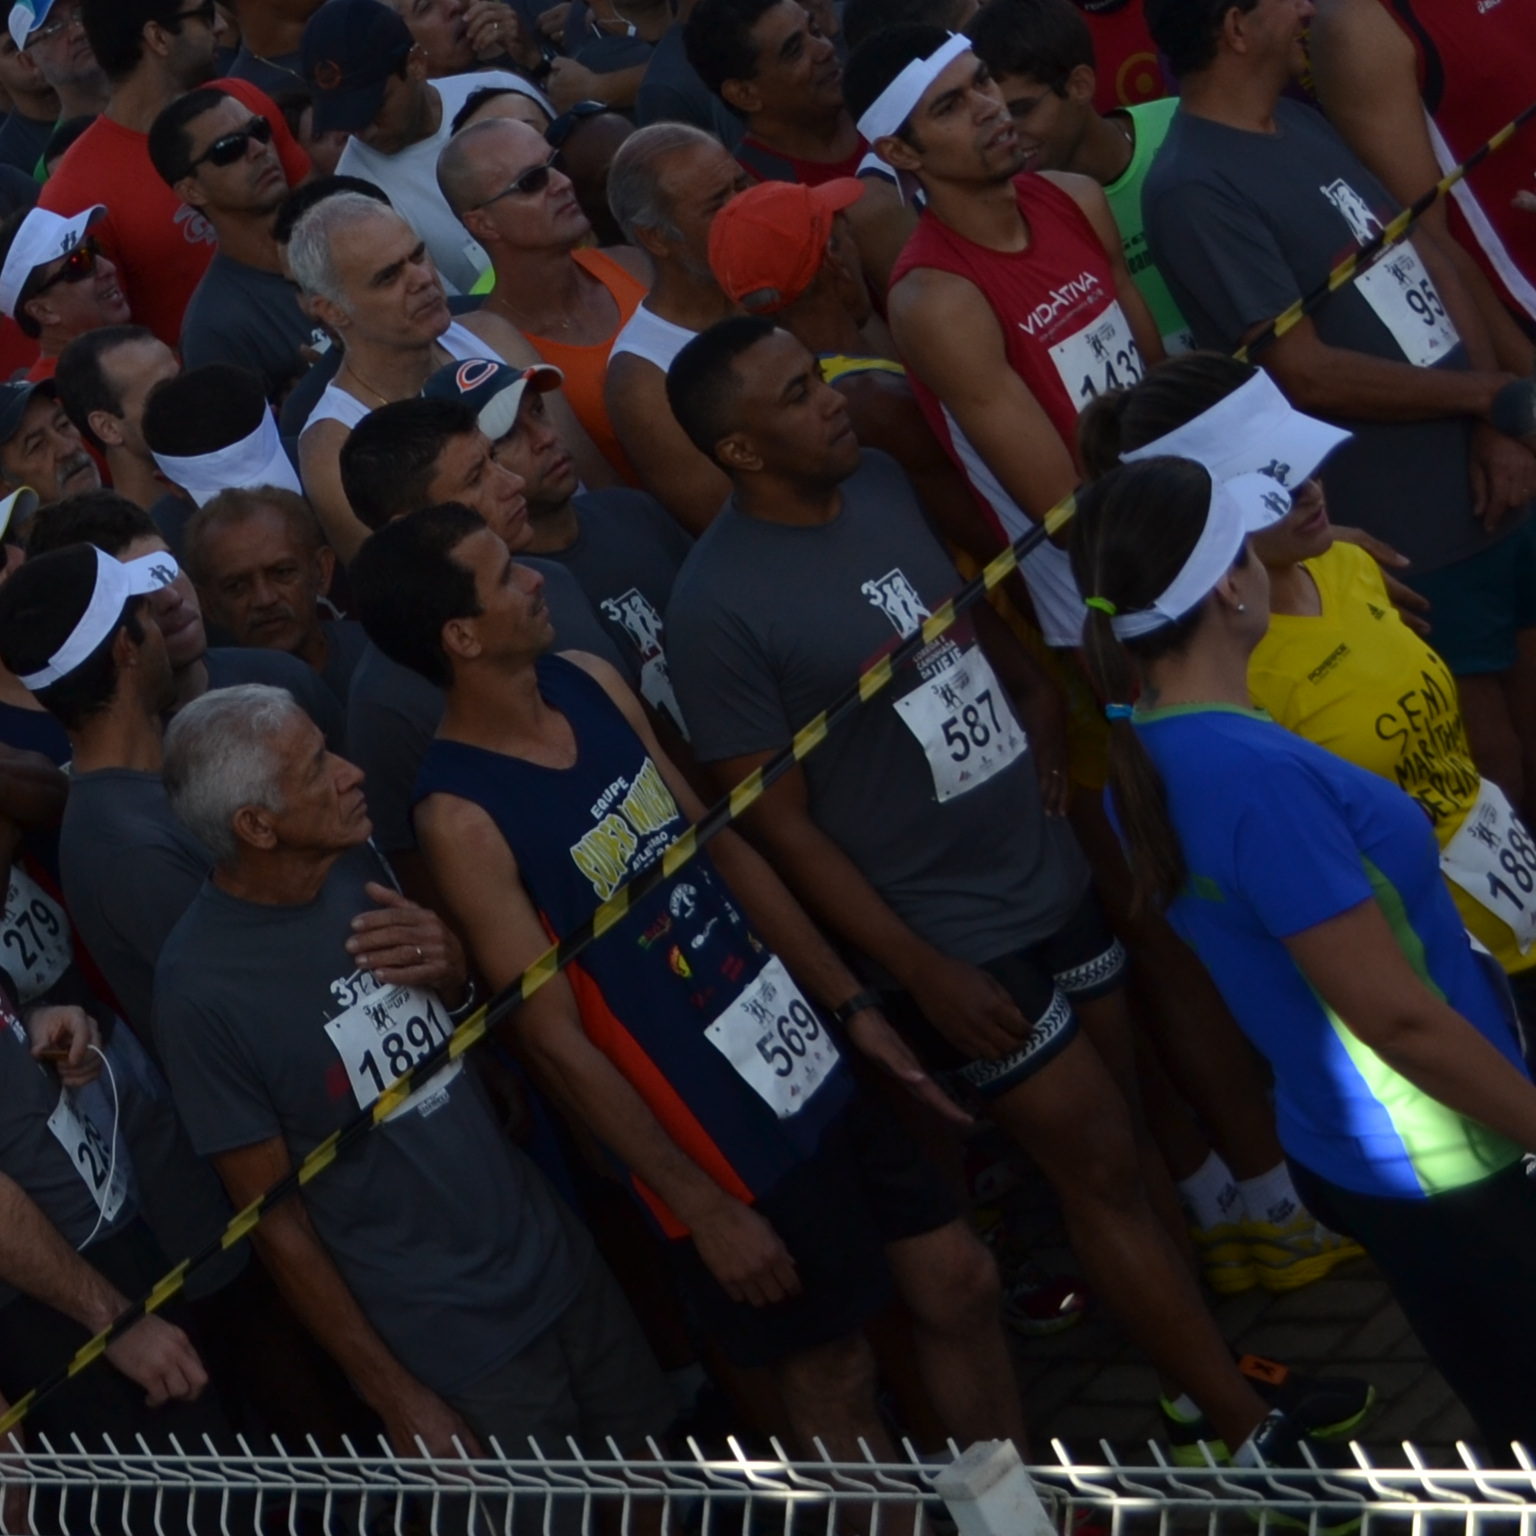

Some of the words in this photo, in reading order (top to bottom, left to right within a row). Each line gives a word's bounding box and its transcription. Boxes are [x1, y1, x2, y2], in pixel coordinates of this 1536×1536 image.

[941, 689, 1002, 762] 587
[3, 898, 60, 970] 279
[359, 998, 448, 1094] 1891
[756, 998, 819, 1078] 569
